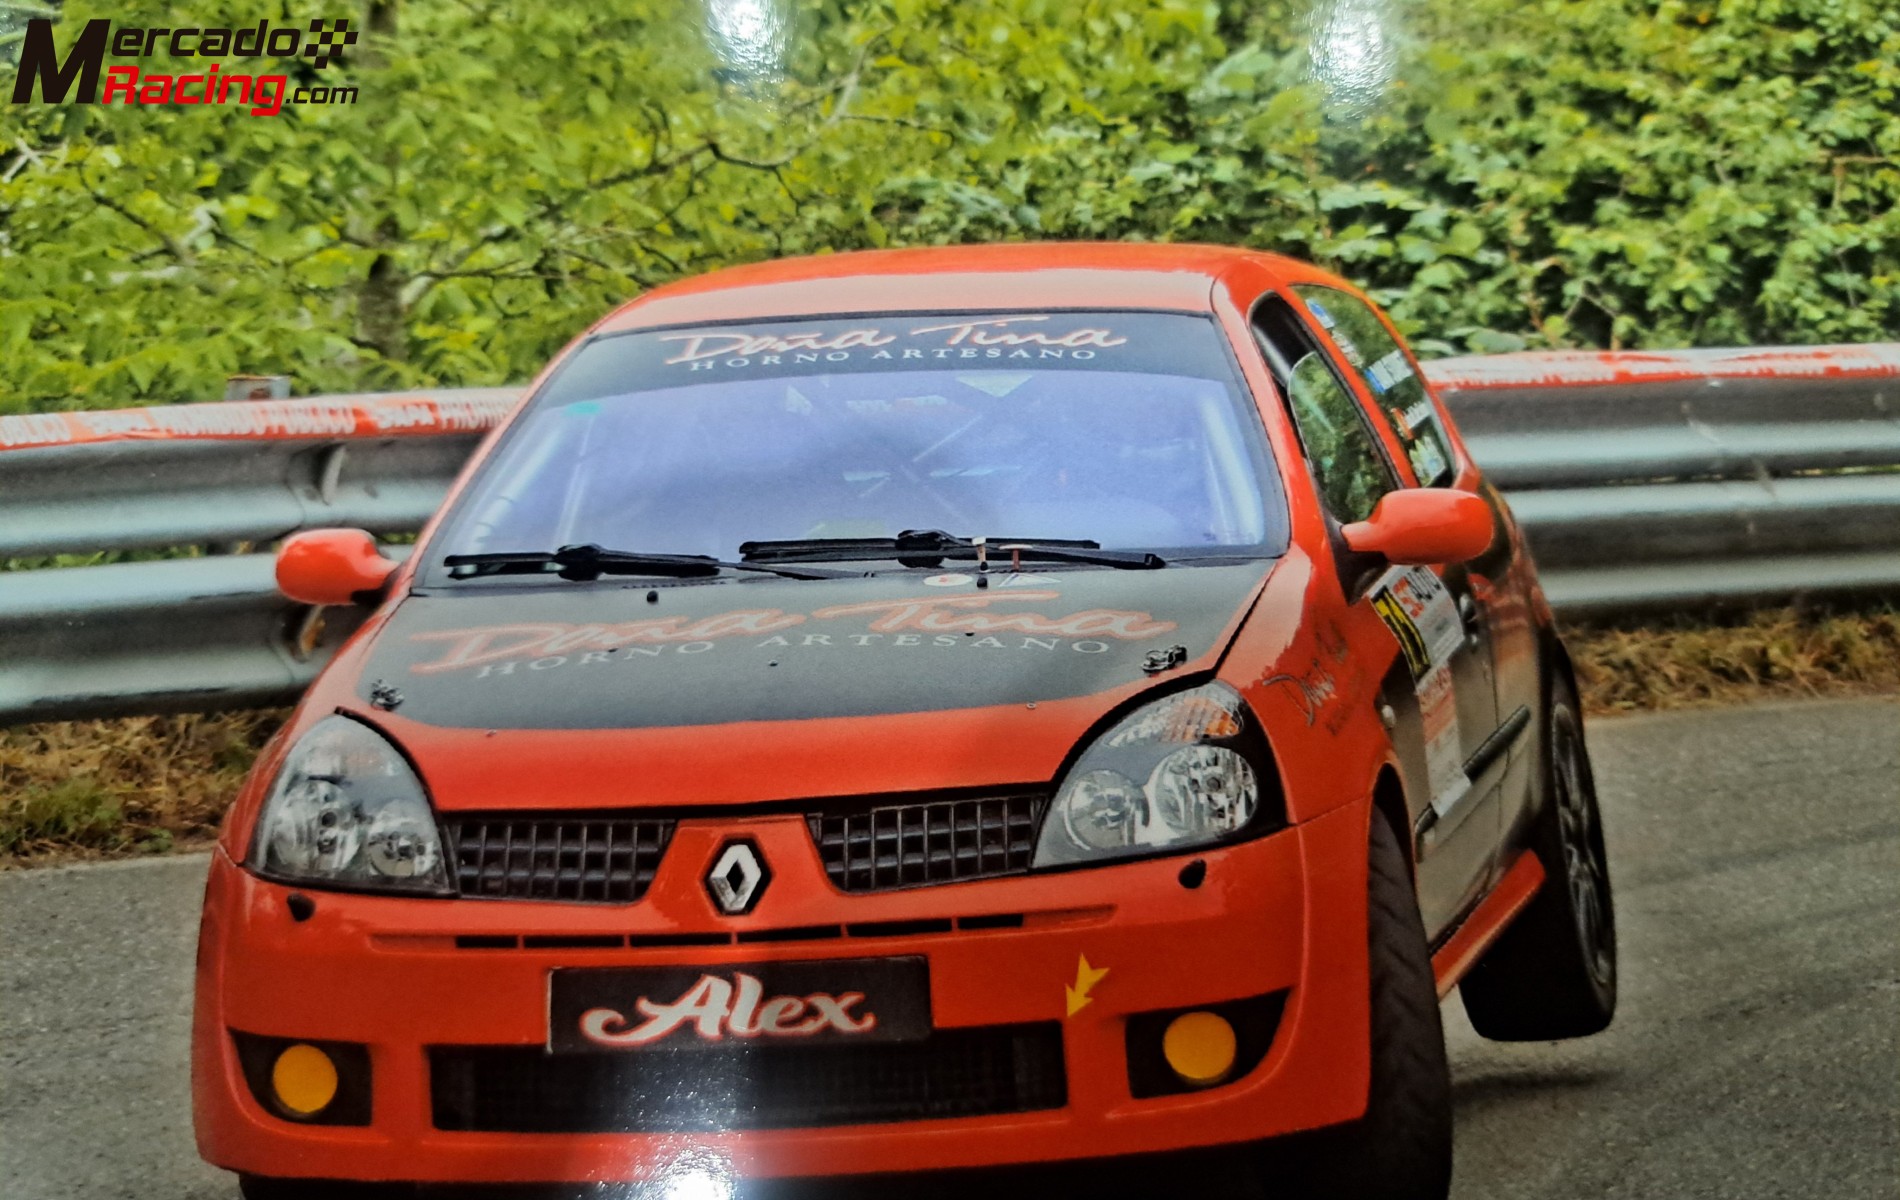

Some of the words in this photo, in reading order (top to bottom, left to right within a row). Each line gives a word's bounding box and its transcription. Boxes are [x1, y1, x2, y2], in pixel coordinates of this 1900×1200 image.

[909, 315, 1128, 348] Tina
[690, 350, 850, 372] HORNO
[871, 348, 1097, 361] ARTESANO
[811, 589, 1179, 640] Tina
[476, 640, 715, 679] HORNO
[756, 633, 1110, 655] ARTESANO
[578, 971, 878, 1047] Alex
